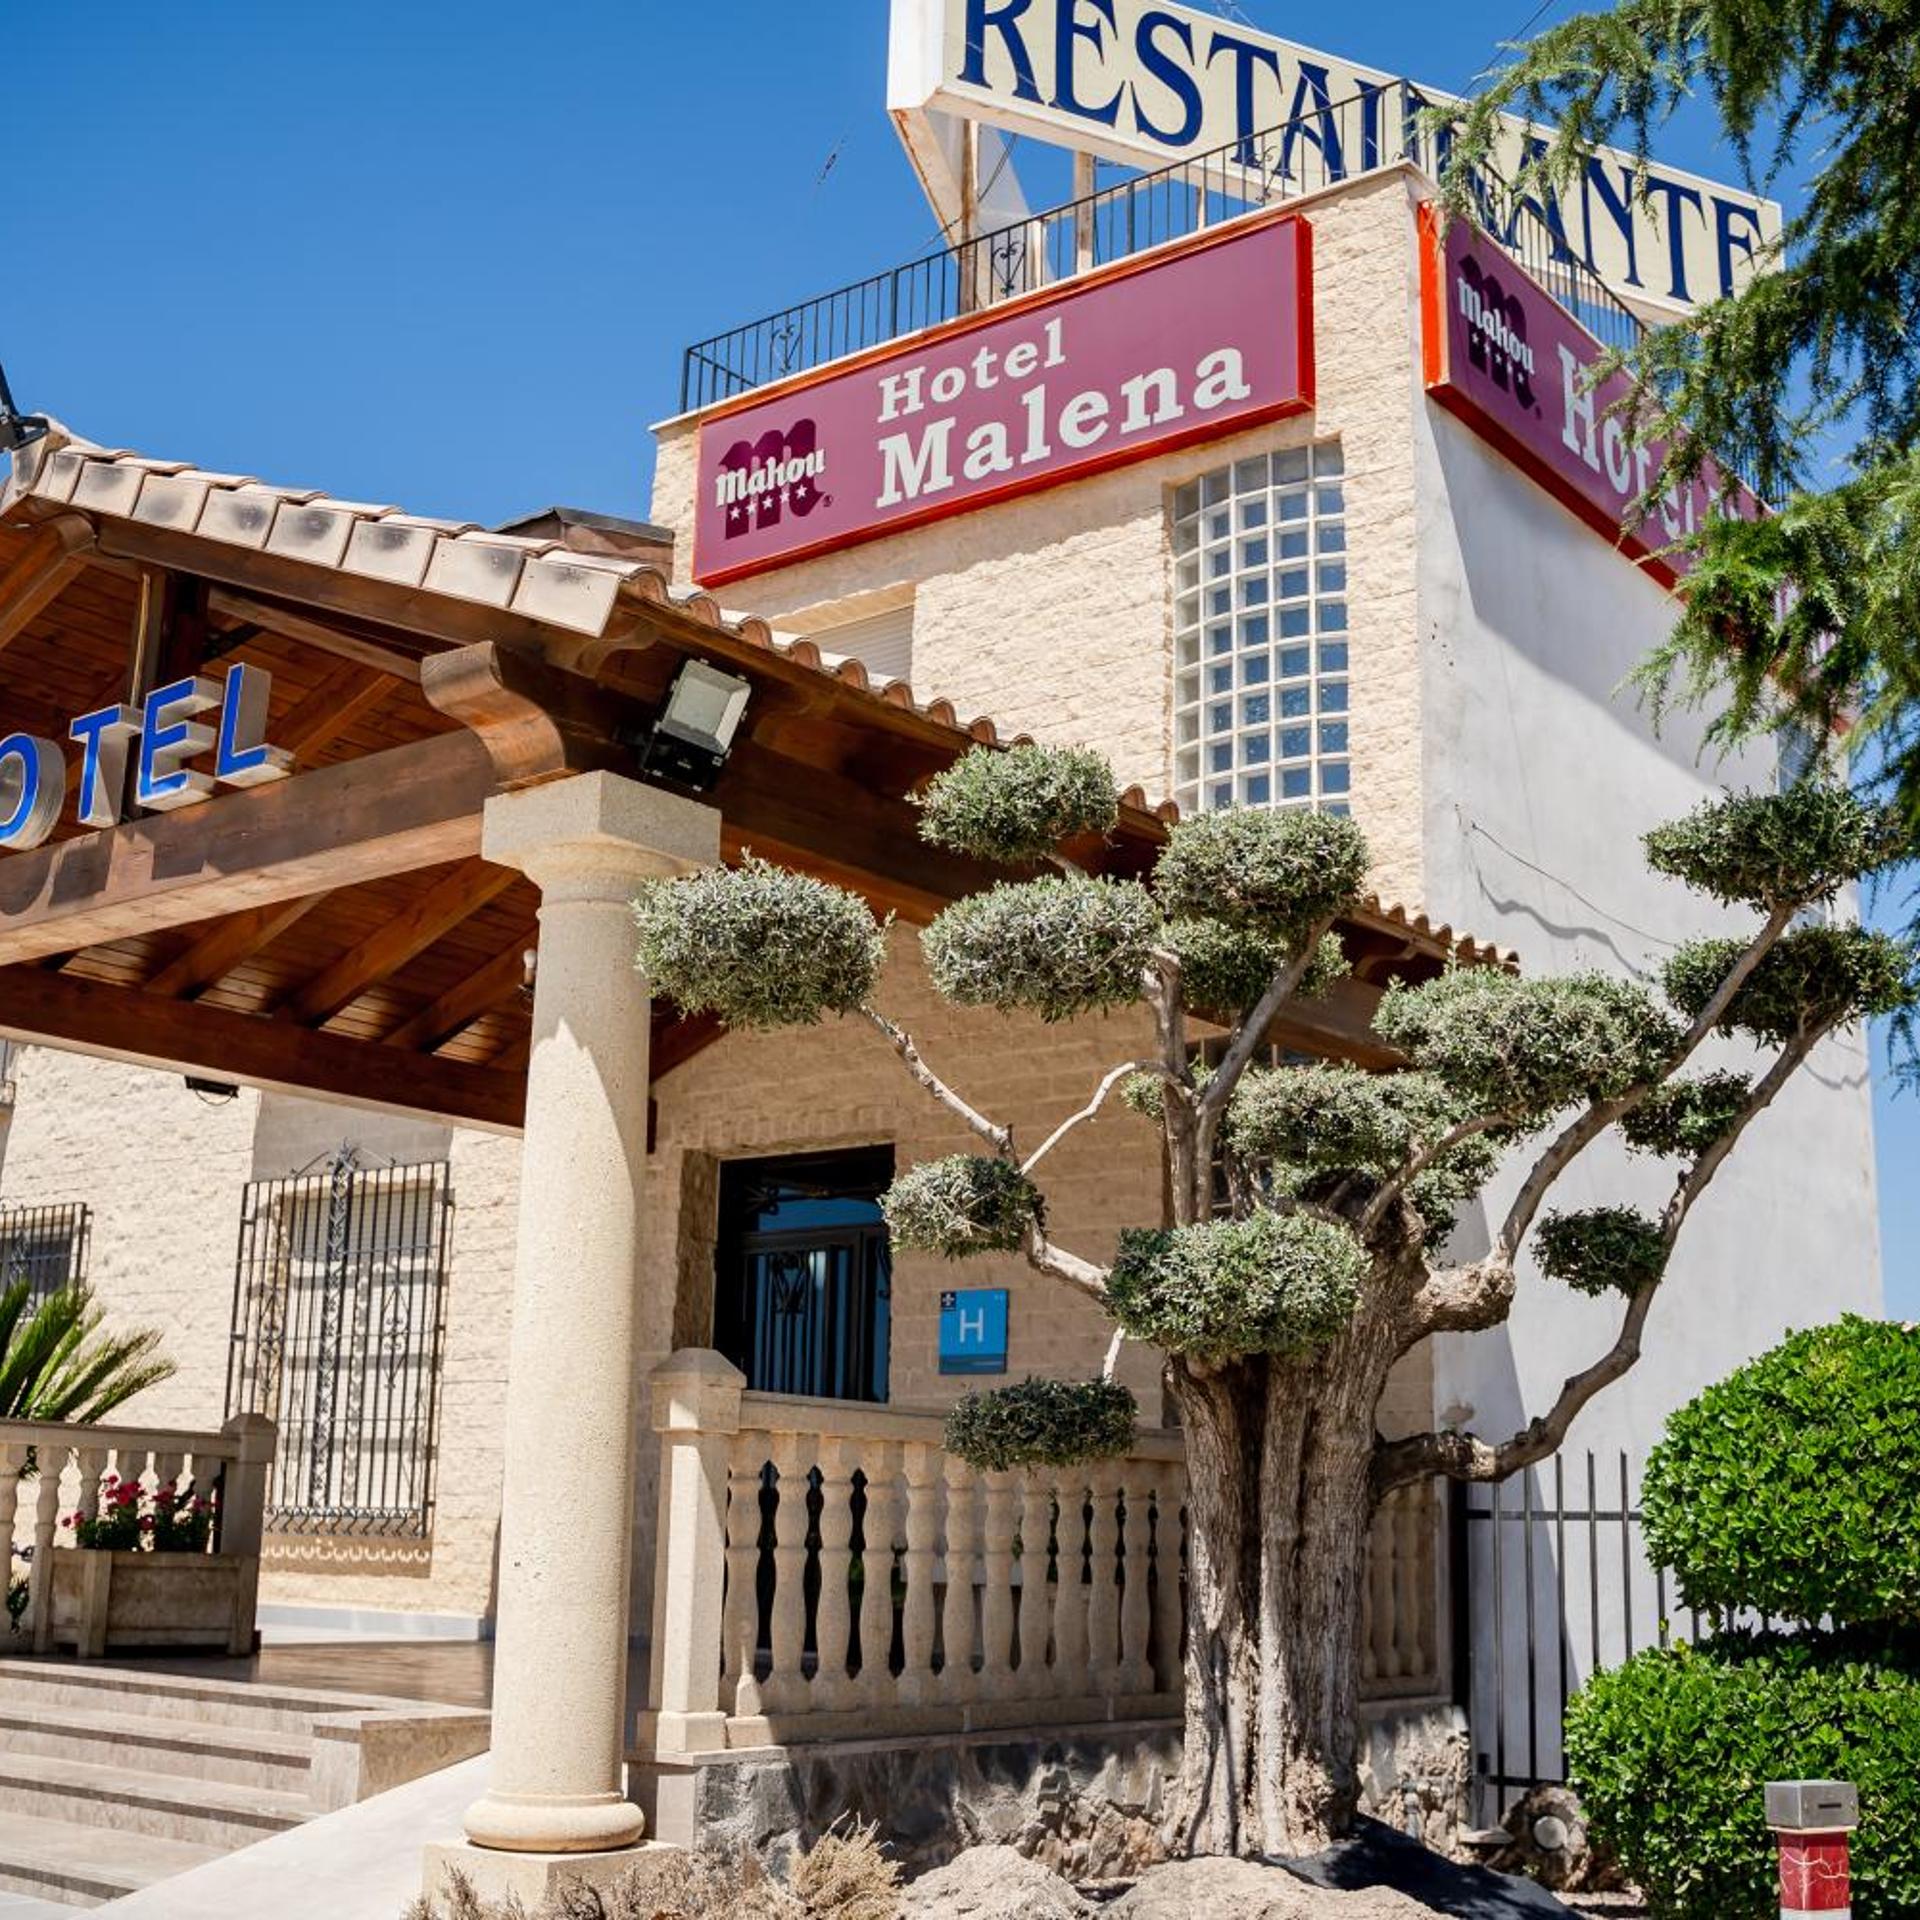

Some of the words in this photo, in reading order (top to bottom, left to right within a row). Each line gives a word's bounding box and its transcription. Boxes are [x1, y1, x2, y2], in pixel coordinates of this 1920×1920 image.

[877, 316, 1067, 424] Hotel
[876, 346, 1251, 508] Malena
[959, 1306, 984, 1344] H
